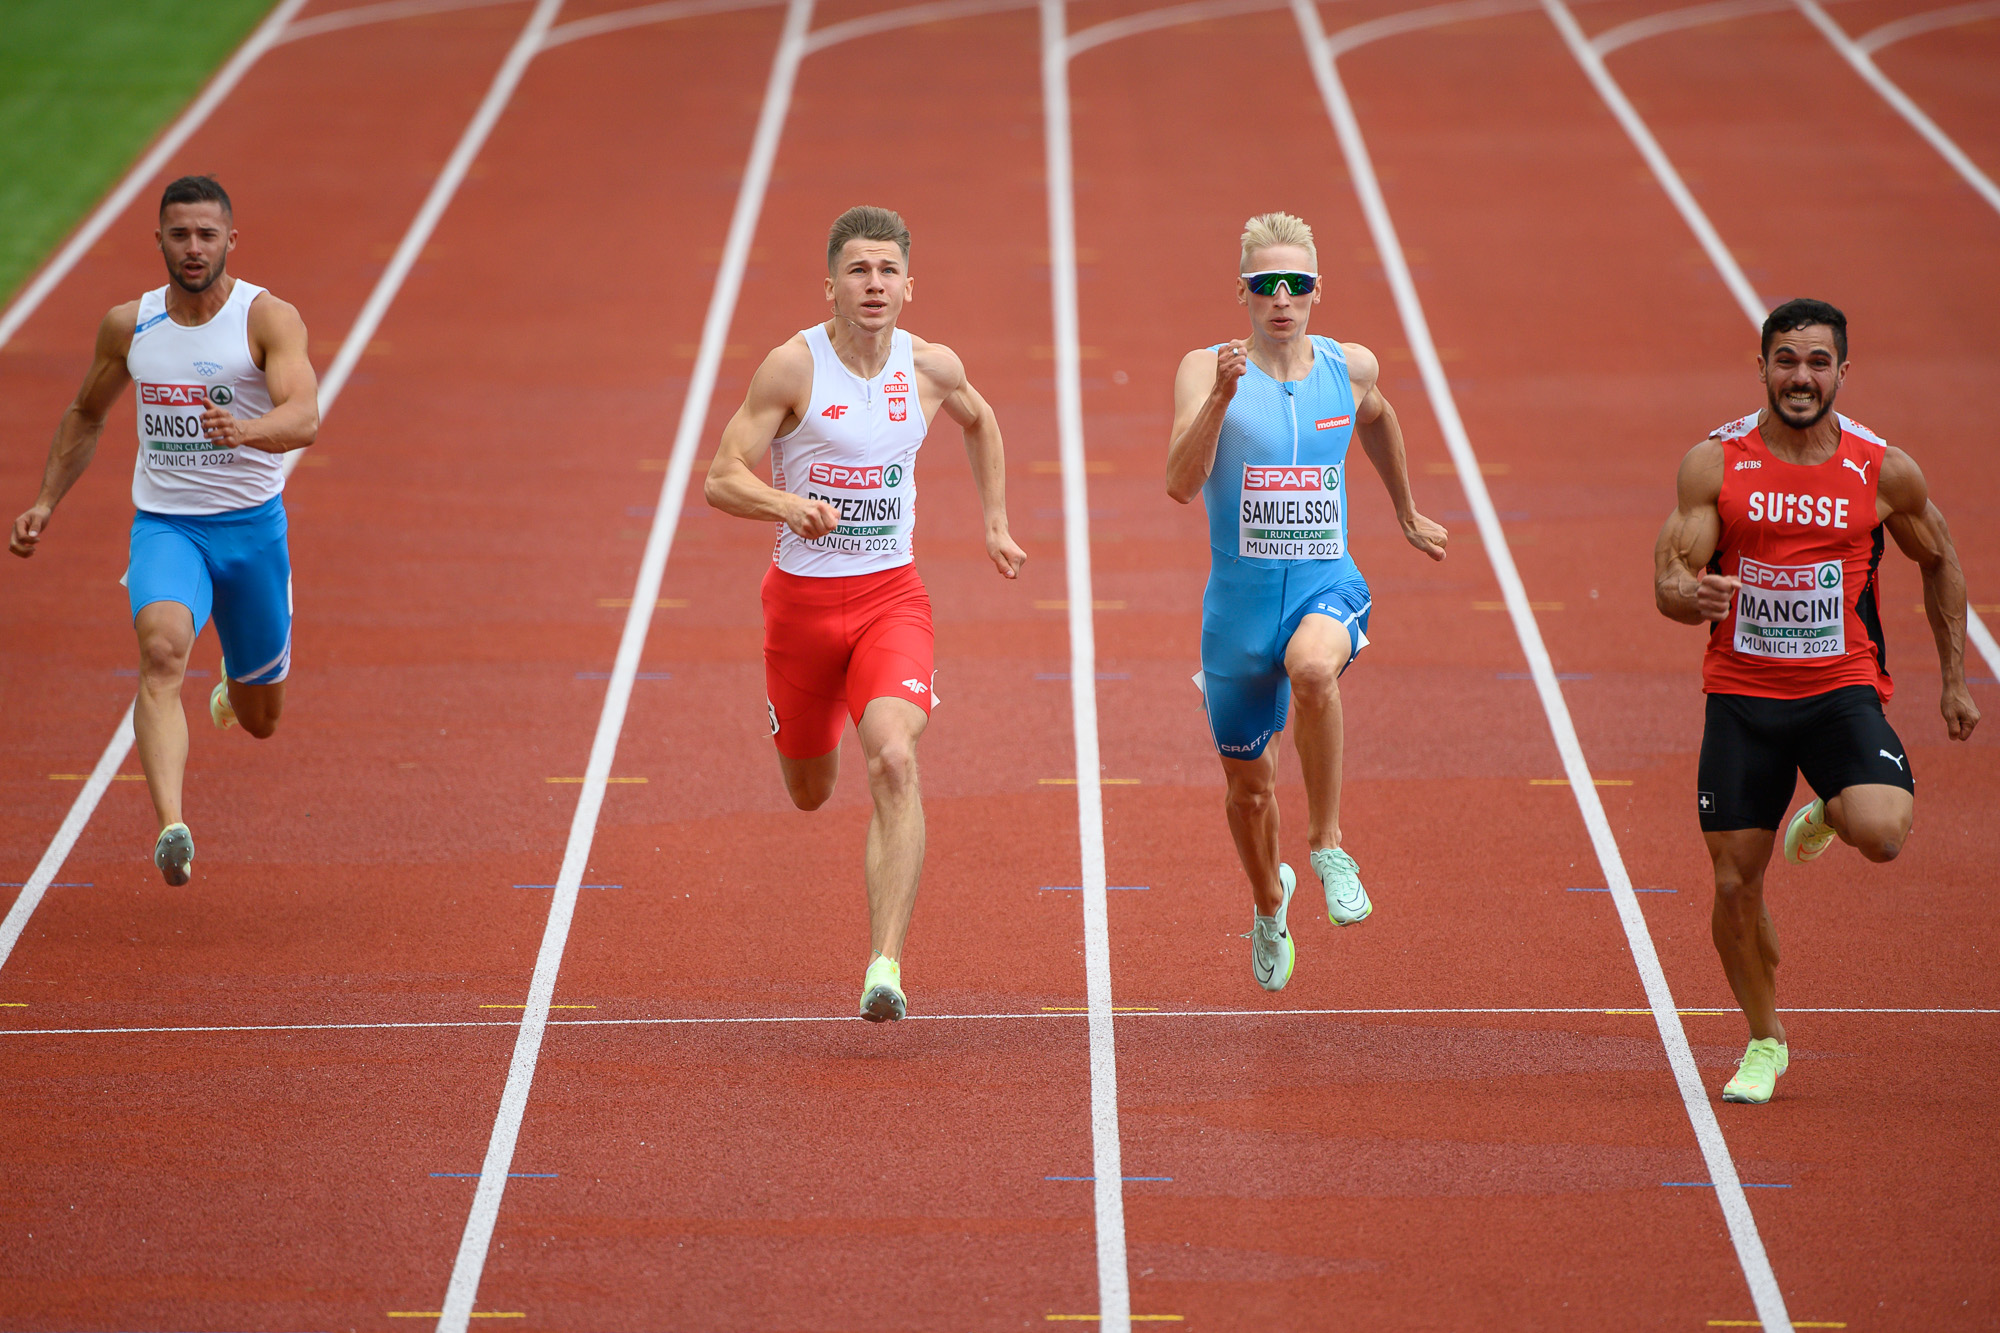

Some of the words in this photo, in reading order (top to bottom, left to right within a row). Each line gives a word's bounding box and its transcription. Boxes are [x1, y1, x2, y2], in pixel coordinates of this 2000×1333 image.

[142, 385, 206, 404] SPAR
[821, 404, 848, 420] 4F
[1317, 416, 1350, 430] motonet
[148, 453, 196, 466] MUNICH
[201, 453, 234, 466] 2022
[1743, 460, 1762, 469] UBS
[811, 465, 881, 487] SPAR
[1246, 470, 1320, 488] SPAR
[1242, 499, 1339, 525] SAMUELSSON
[1270, 530, 1291, 539] RUN
[865, 538, 897, 551] 2022
[1246, 541, 1303, 556] MUNICH
[1308, 542, 1339, 556] 2022
[1742, 563, 1814, 588] SPAR
[1740, 593, 1839, 623] MANCINI
[1762, 628, 1783, 637] RUN
[1741, 635, 1797, 654] MUNICH
[1803, 638, 1838, 654] 2022
[901, 678, 928, 694] 4F
[1221, 735, 1262, 752] CRAFT
